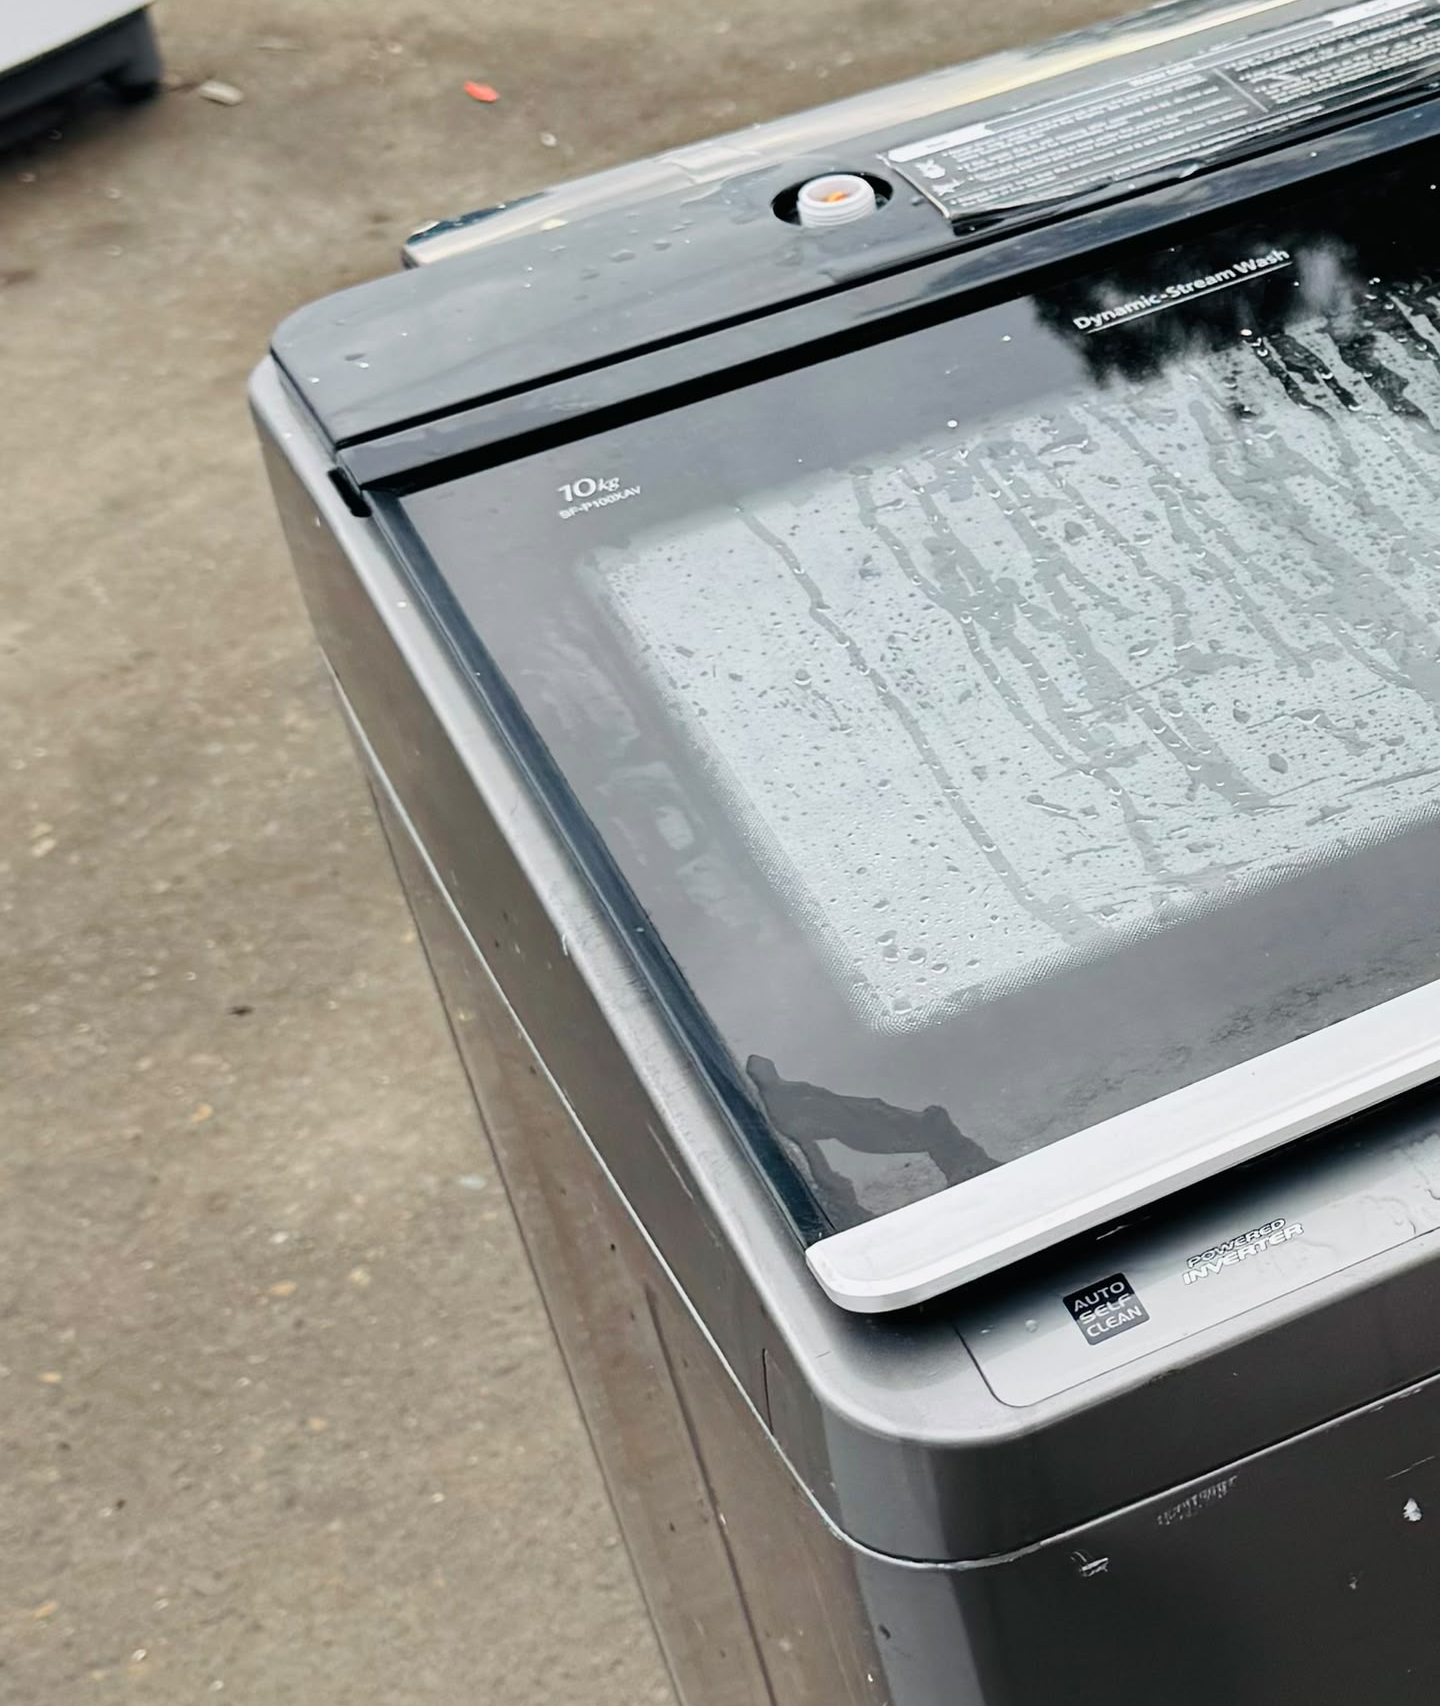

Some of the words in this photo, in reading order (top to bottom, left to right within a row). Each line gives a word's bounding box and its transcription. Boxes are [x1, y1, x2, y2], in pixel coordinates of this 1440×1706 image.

[1072, 268, 1237, 330] Dynamic-Stream
[1232, 248, 1290, 274] Wash
[1183, 1223, 1305, 1286] INVERTER
[1186, 1218, 1286, 1269] POWERED
[1073, 1281, 1126, 1312] AUTO
[1079, 1293, 1133, 1325] SELF
[1086, 1306, 1143, 1339] CLEAN
